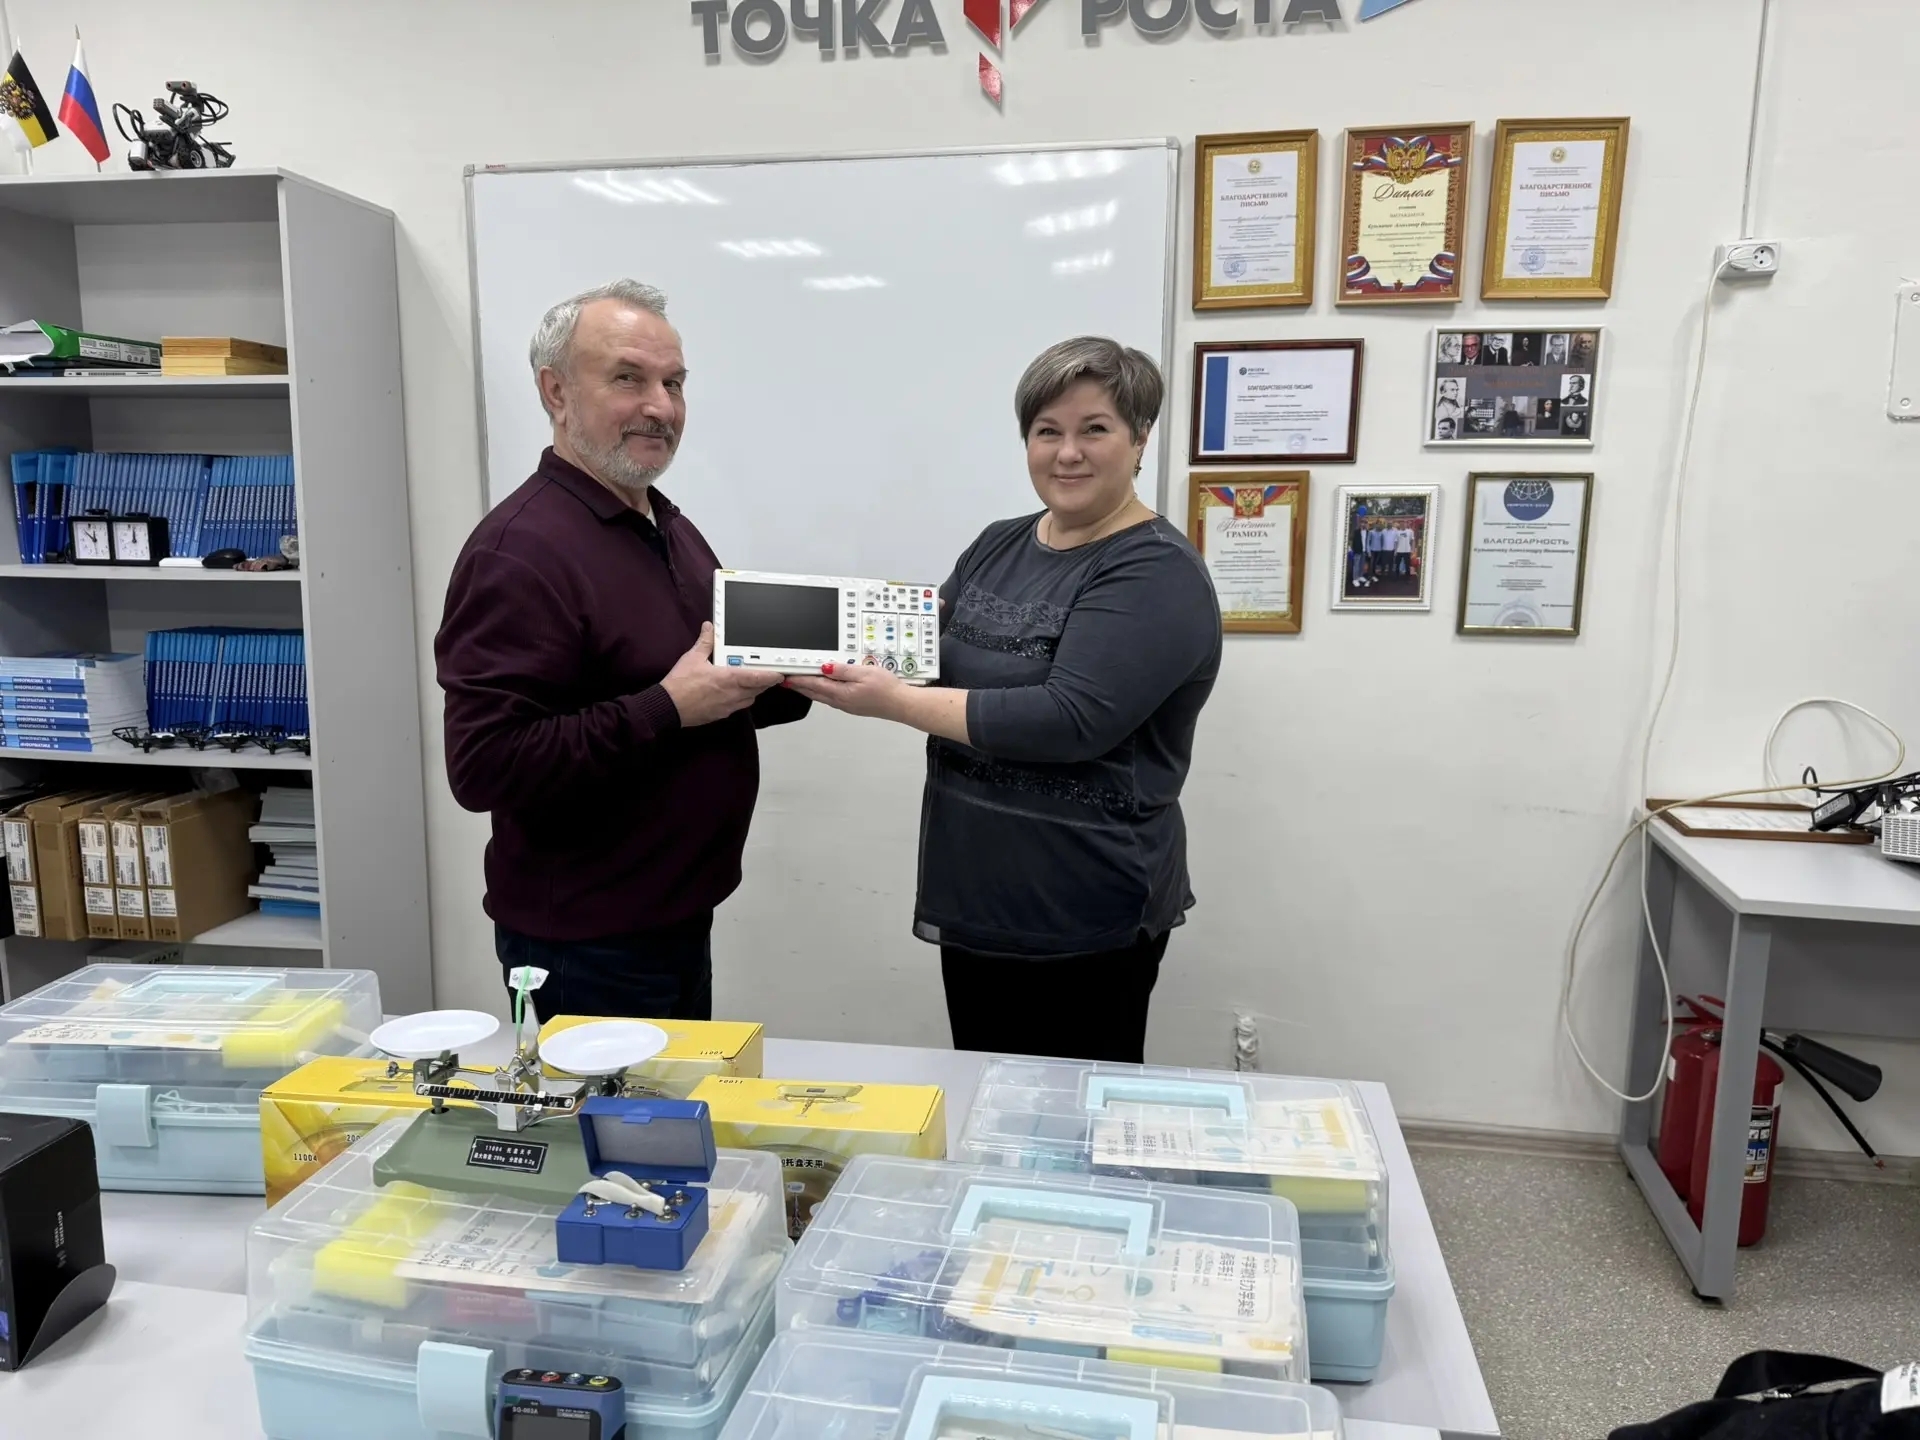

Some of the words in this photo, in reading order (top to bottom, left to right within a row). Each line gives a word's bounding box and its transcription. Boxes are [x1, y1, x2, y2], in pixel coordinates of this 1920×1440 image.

[691, 0, 946, 54] ТОЧКА
[1520, 182, 1592, 190] БЛАГОДАРСТВЕННОЕ
[1220, 192, 1288, 201] БЛАГОДАРСТВЕННОЕ
[1373, 183, 1434, 202] Диплом
[1483, 537, 1570, 546] БЛАГОДАРНОСТЬ
[293, 1153, 318, 1162] 11004
